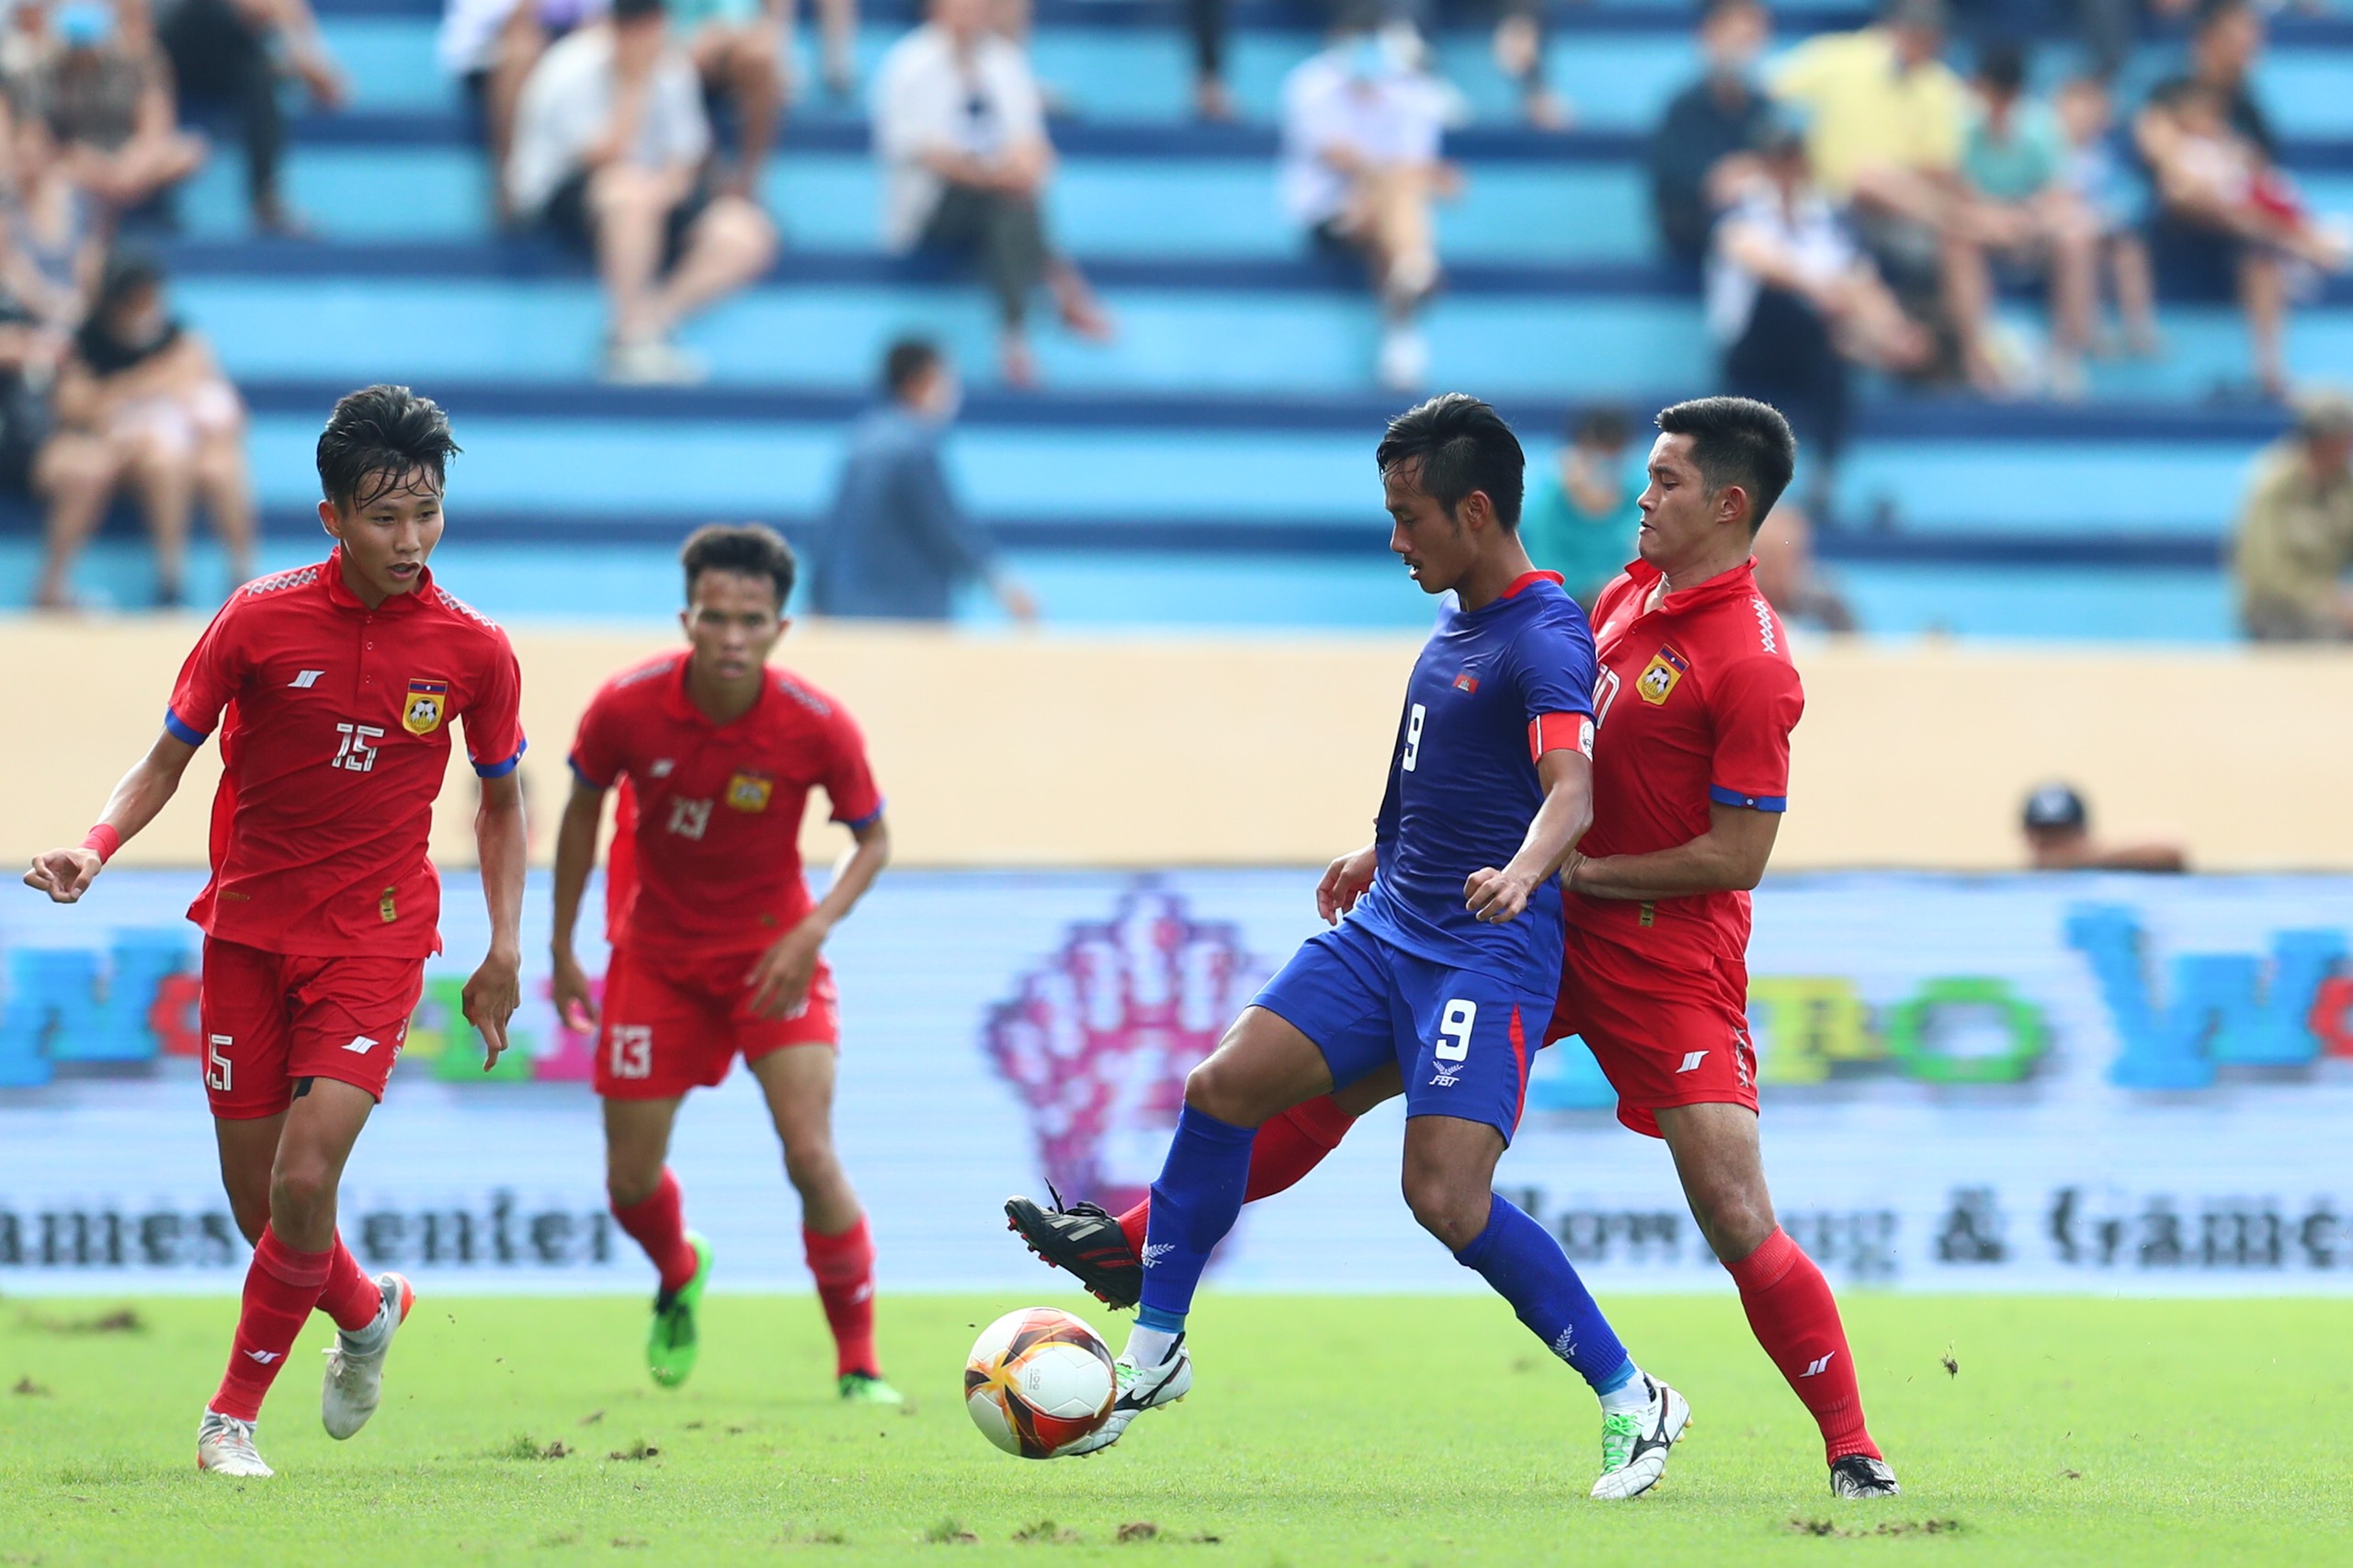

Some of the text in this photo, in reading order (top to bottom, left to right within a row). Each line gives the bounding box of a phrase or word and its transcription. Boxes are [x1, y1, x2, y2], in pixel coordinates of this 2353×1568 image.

[332, 722, 384, 771] 15
[1403, 703, 1427, 772] 9
[610, 1024, 652, 1078] 13
[1435, 998, 1477, 1062] 9
[360, 1186, 614, 1267] enter
